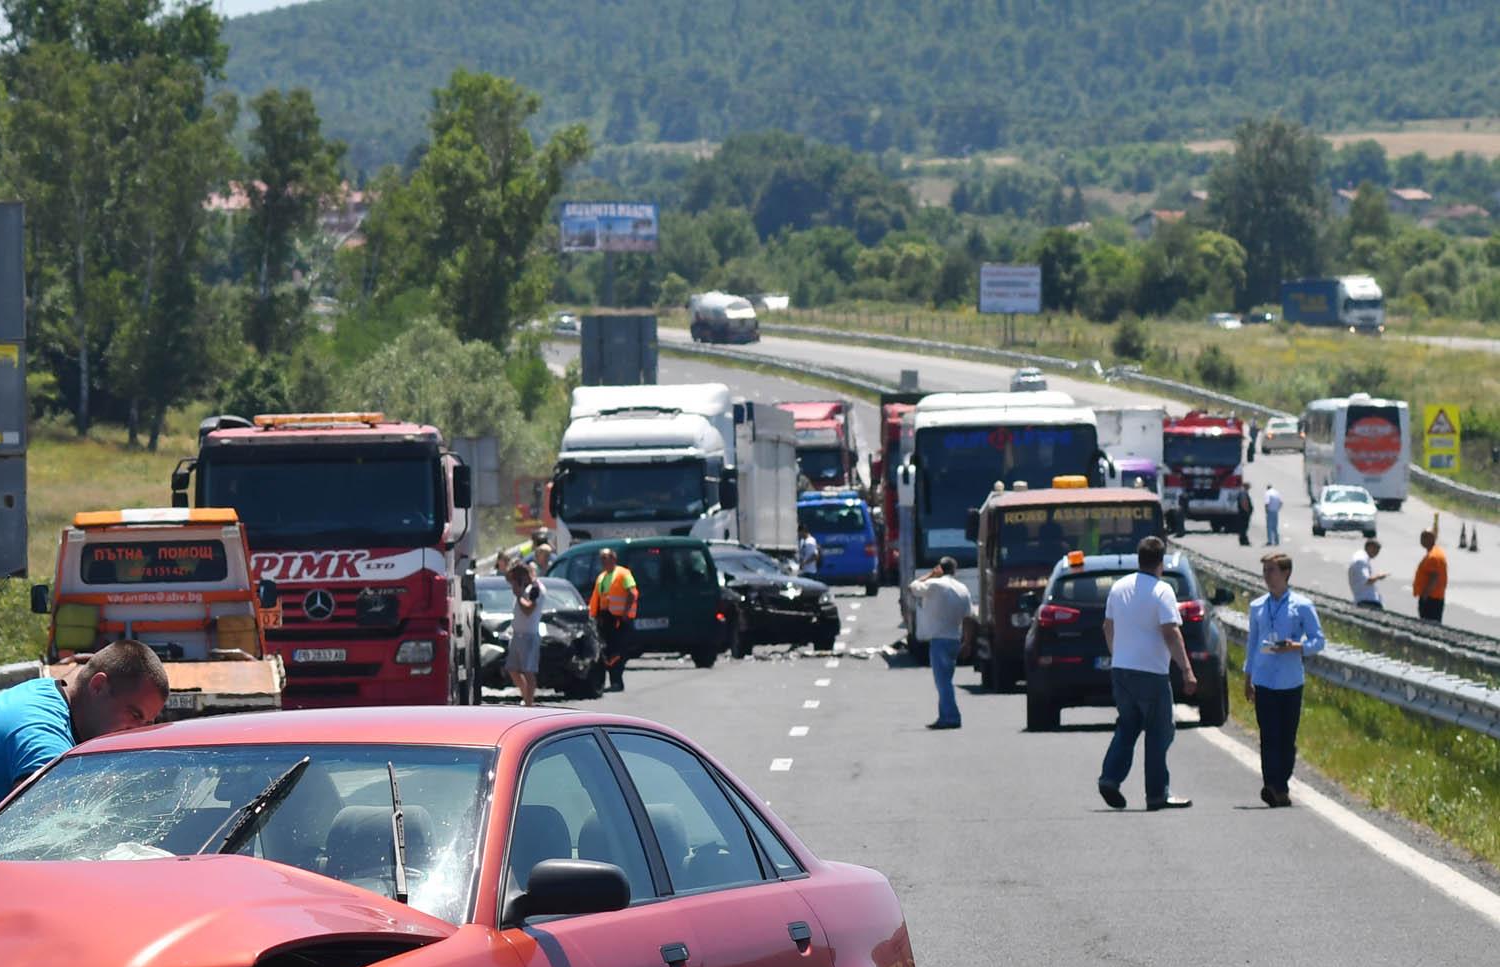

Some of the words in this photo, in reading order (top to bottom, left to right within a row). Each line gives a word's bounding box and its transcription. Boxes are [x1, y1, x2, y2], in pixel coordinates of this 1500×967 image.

[1004, 509, 1048, 524] ROAD
[1053, 506, 1154, 521] ASSISTANCE
[93, 548, 144, 561] ПЪТНА
[157, 545, 214, 561] ПОМОЩ
[252, 552, 368, 580] PIMK
[365, 562, 396, 571] LTD
